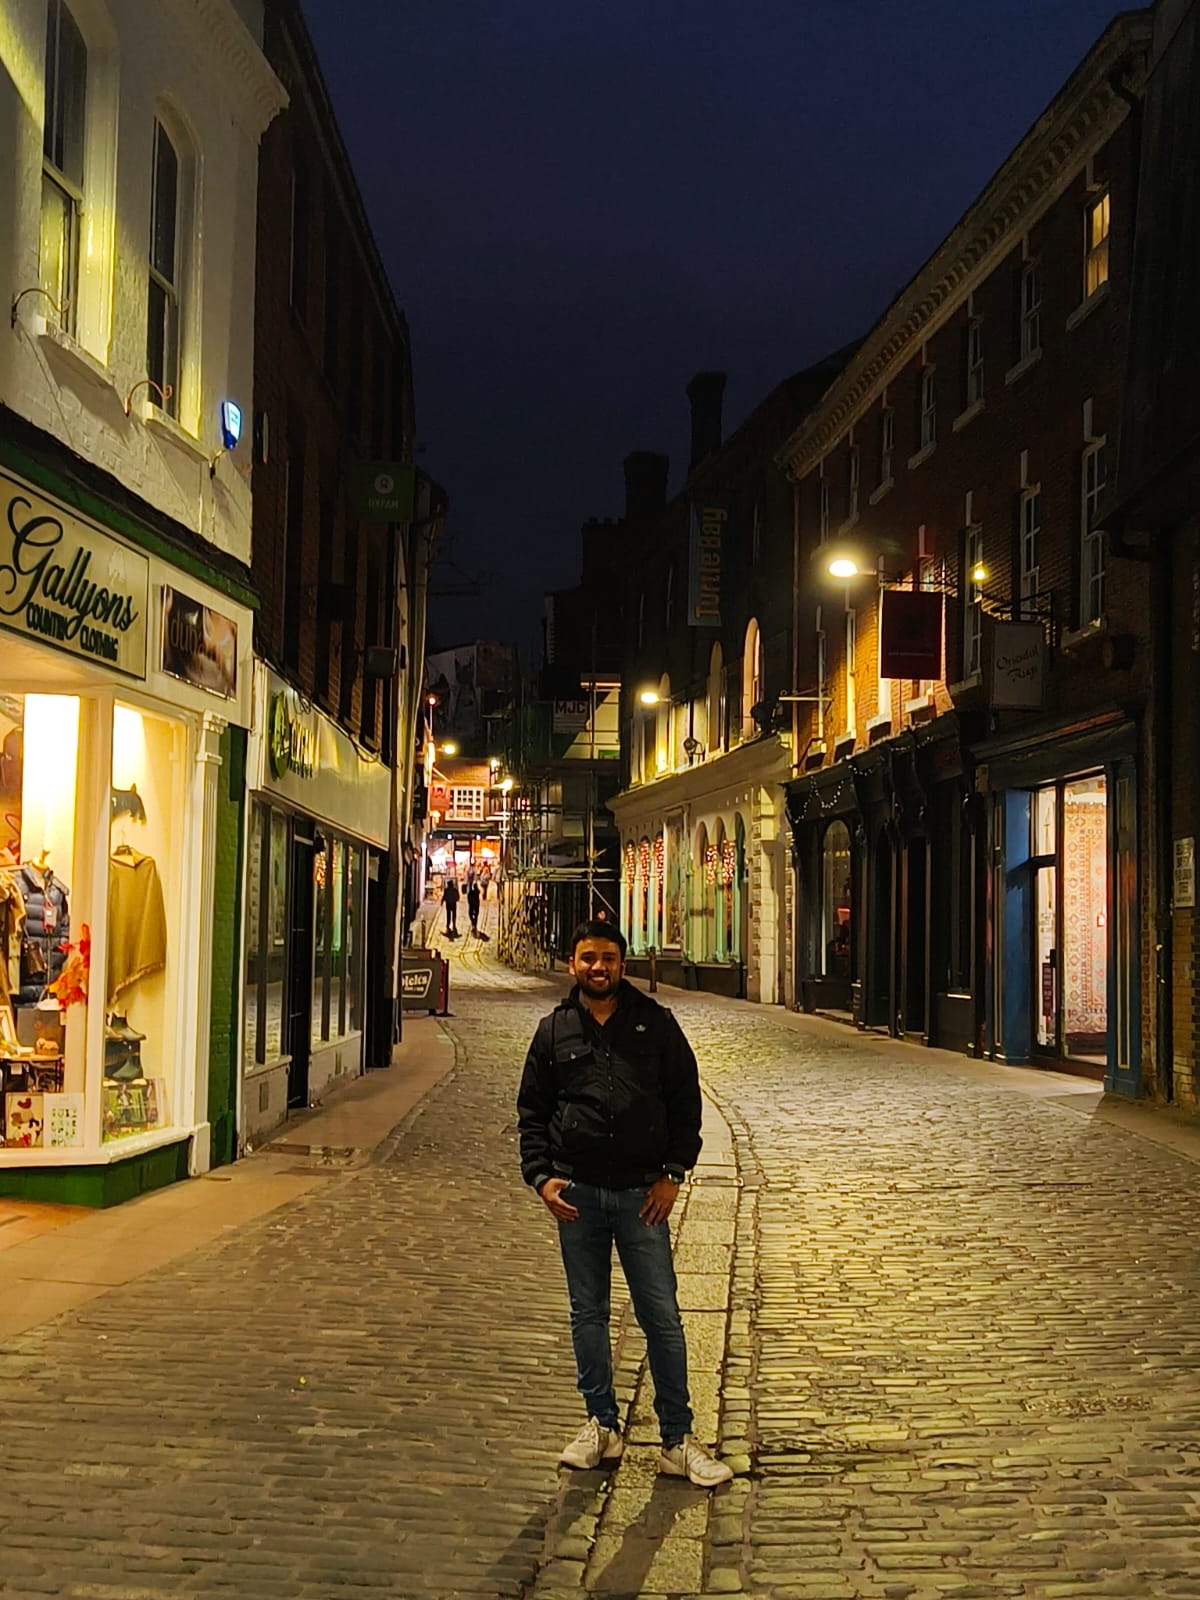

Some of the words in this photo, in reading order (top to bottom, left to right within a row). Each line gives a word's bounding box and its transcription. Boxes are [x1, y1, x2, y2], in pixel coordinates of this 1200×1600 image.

[698, 506, 728, 549] Bay
[0, 496, 139, 640] Gallyons
[694, 552, 721, 619] Turtle
[80, 625, 118, 662] CLOTHING
[555, 700, 586, 714] MJC
